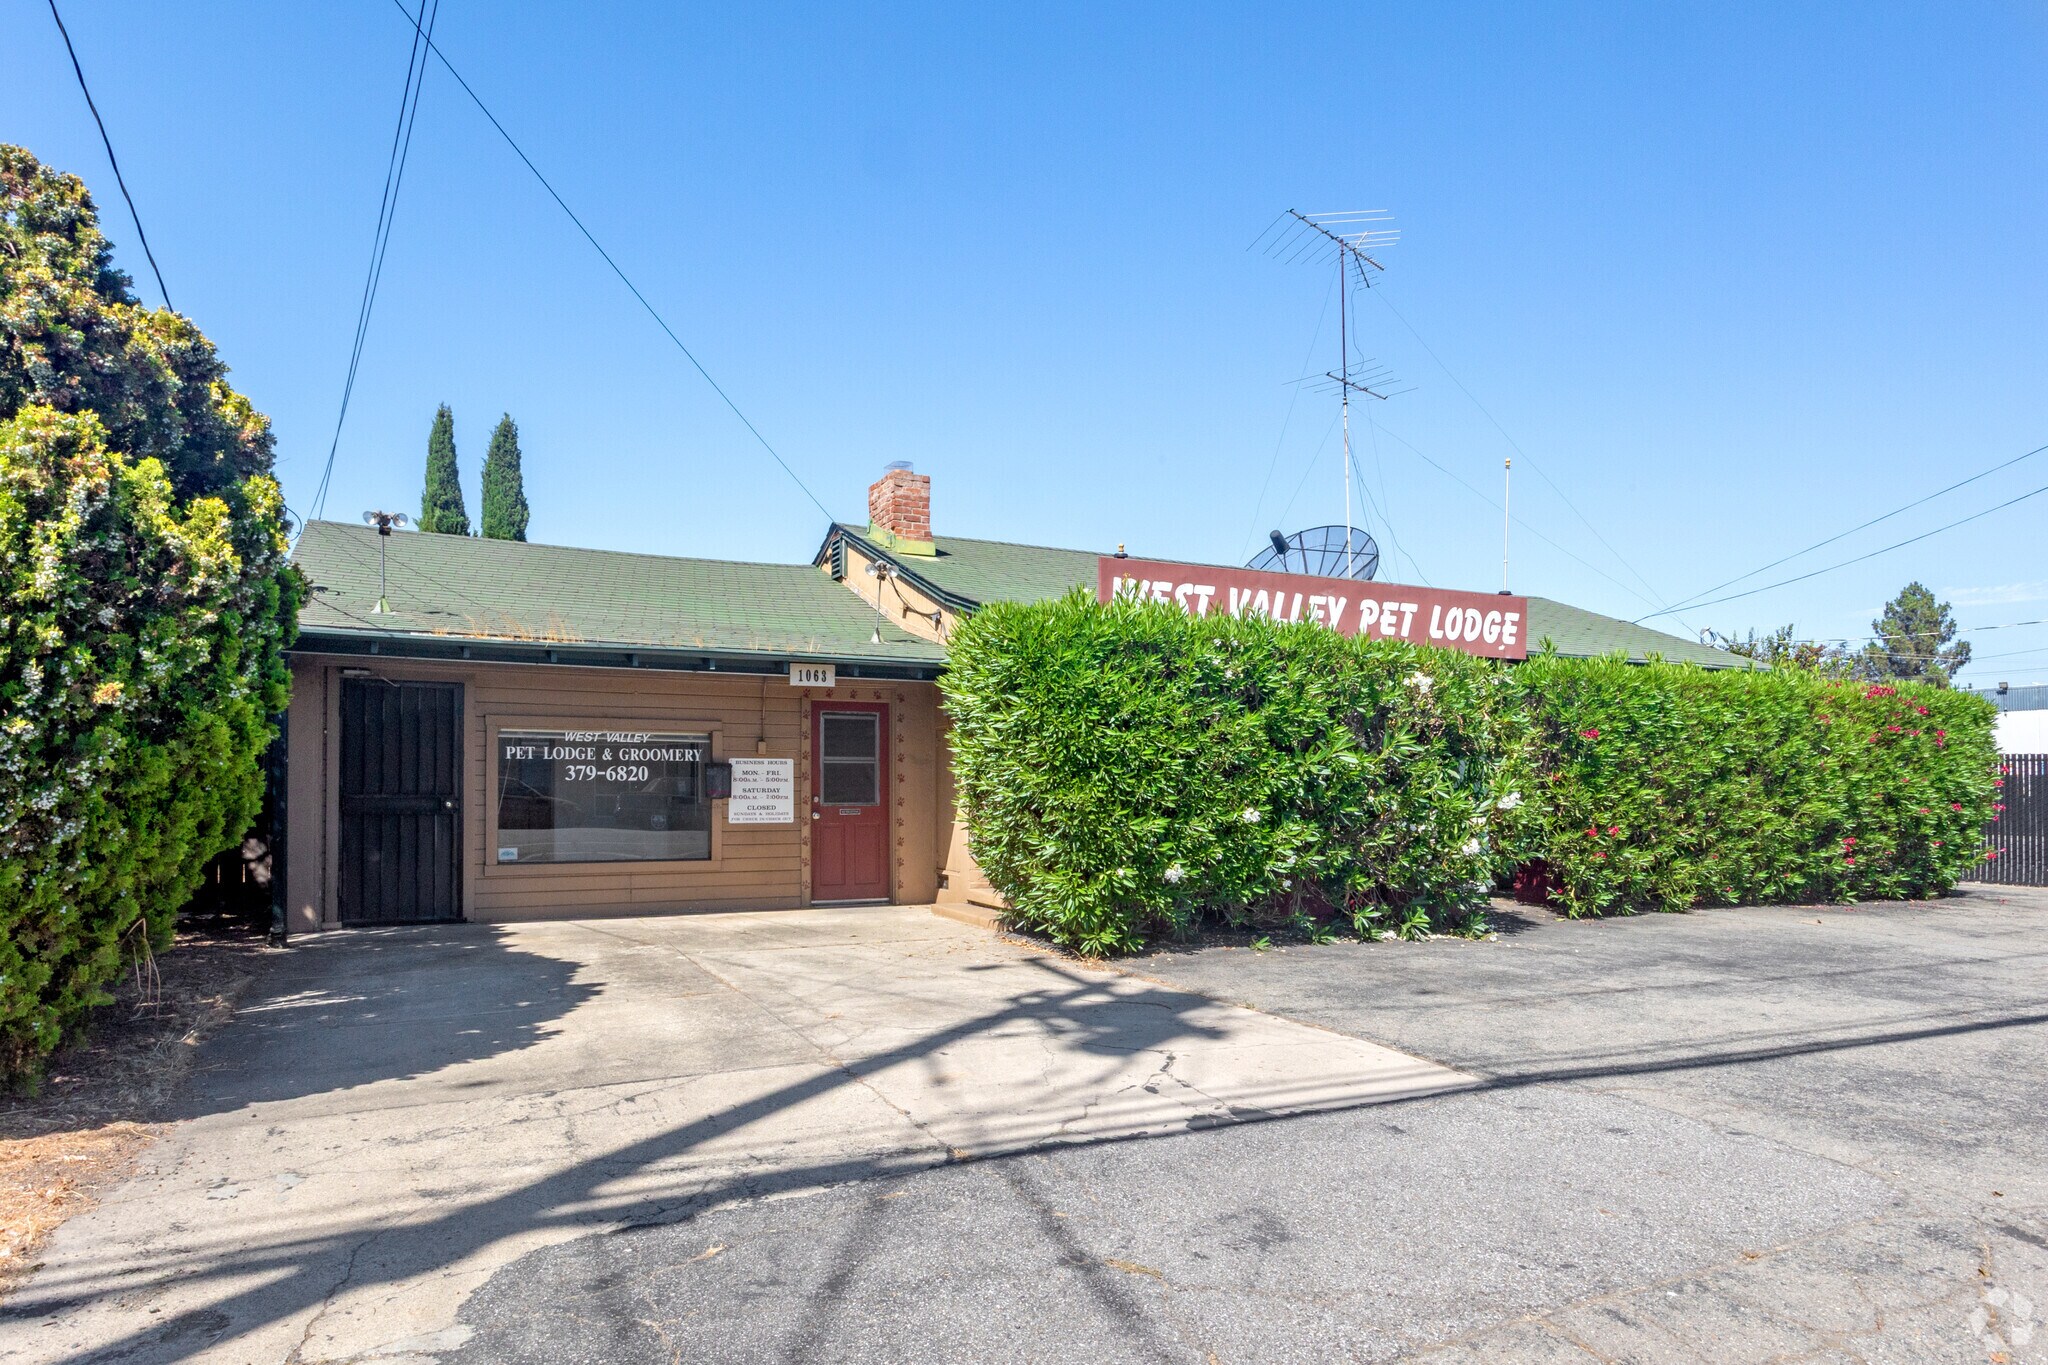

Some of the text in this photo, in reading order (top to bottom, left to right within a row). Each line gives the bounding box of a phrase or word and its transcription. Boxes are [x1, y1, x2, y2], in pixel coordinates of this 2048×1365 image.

[1112, 576, 1520, 645] WEST VALLEY PET LODGE
[798, 669, 827, 682] 1063
[564, 732, 651, 743] WEST VALLEY
[505, 746, 702, 762] PET LODGE & GROOMERY
[565, 765, 649, 782] 379-6820
